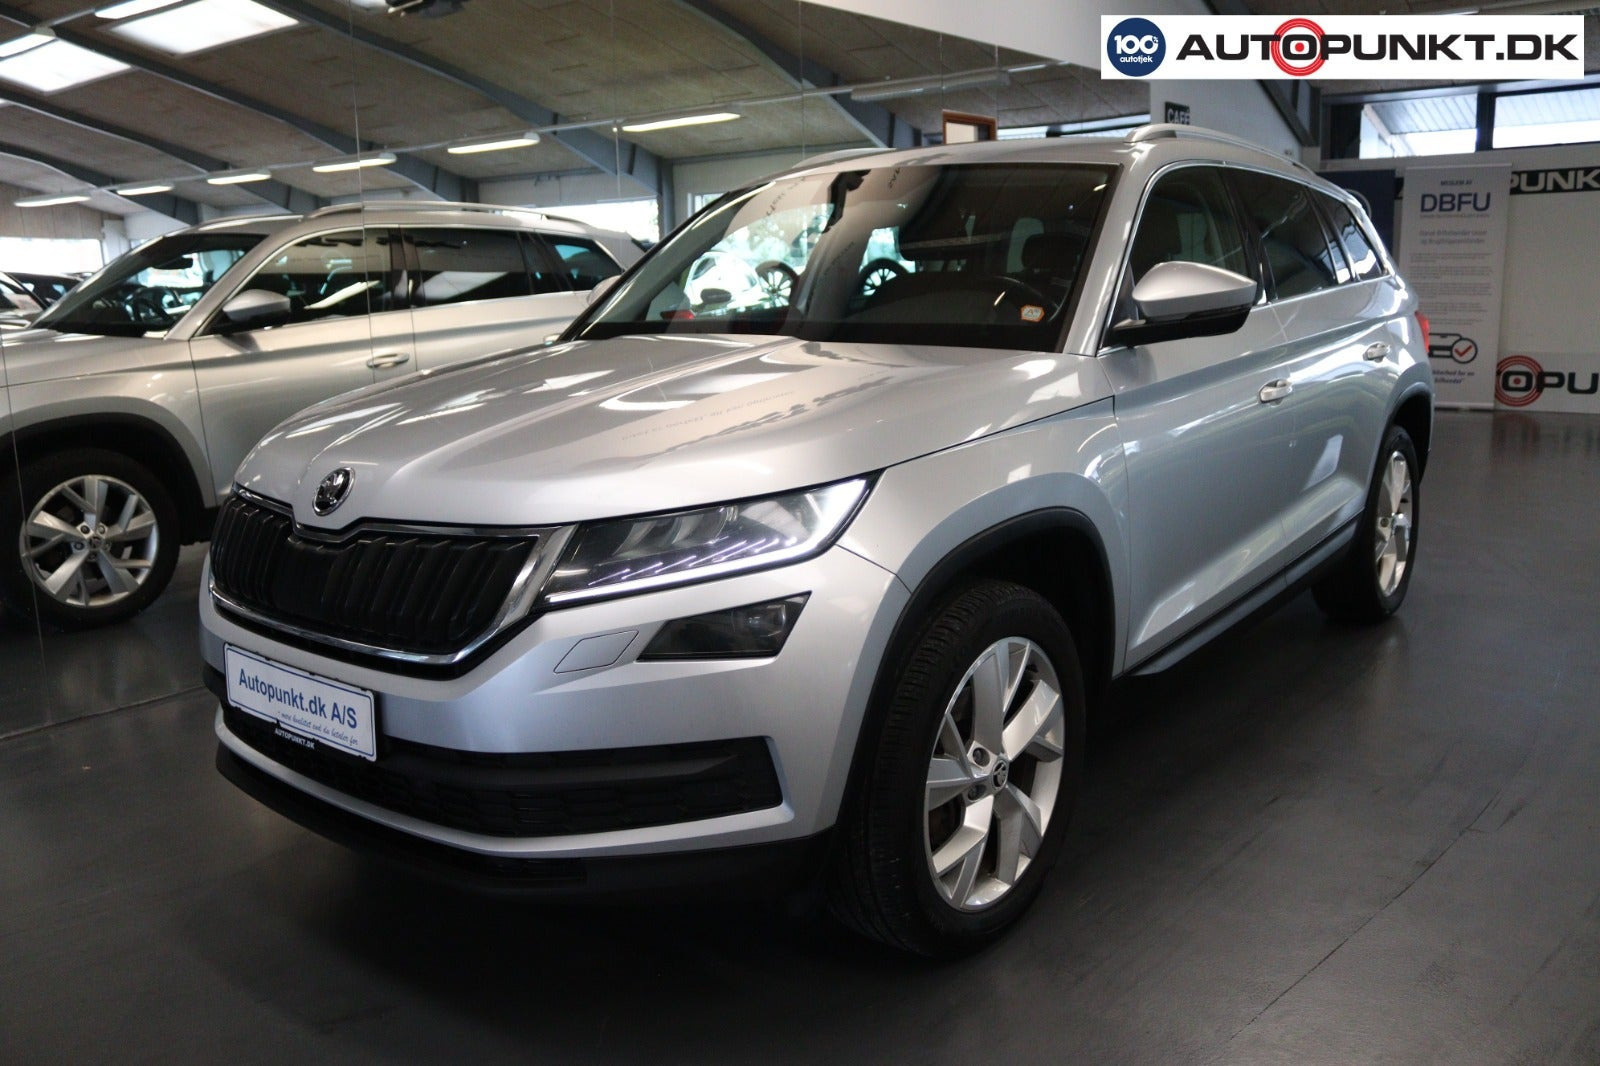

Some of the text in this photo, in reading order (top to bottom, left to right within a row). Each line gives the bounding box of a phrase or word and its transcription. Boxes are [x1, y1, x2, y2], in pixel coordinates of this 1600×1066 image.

[1420, 192, 1491, 212] DBFU
[1497, 369, 1599, 394] OPU
[239, 668, 357, 729] Autopunkt.dk A/S
